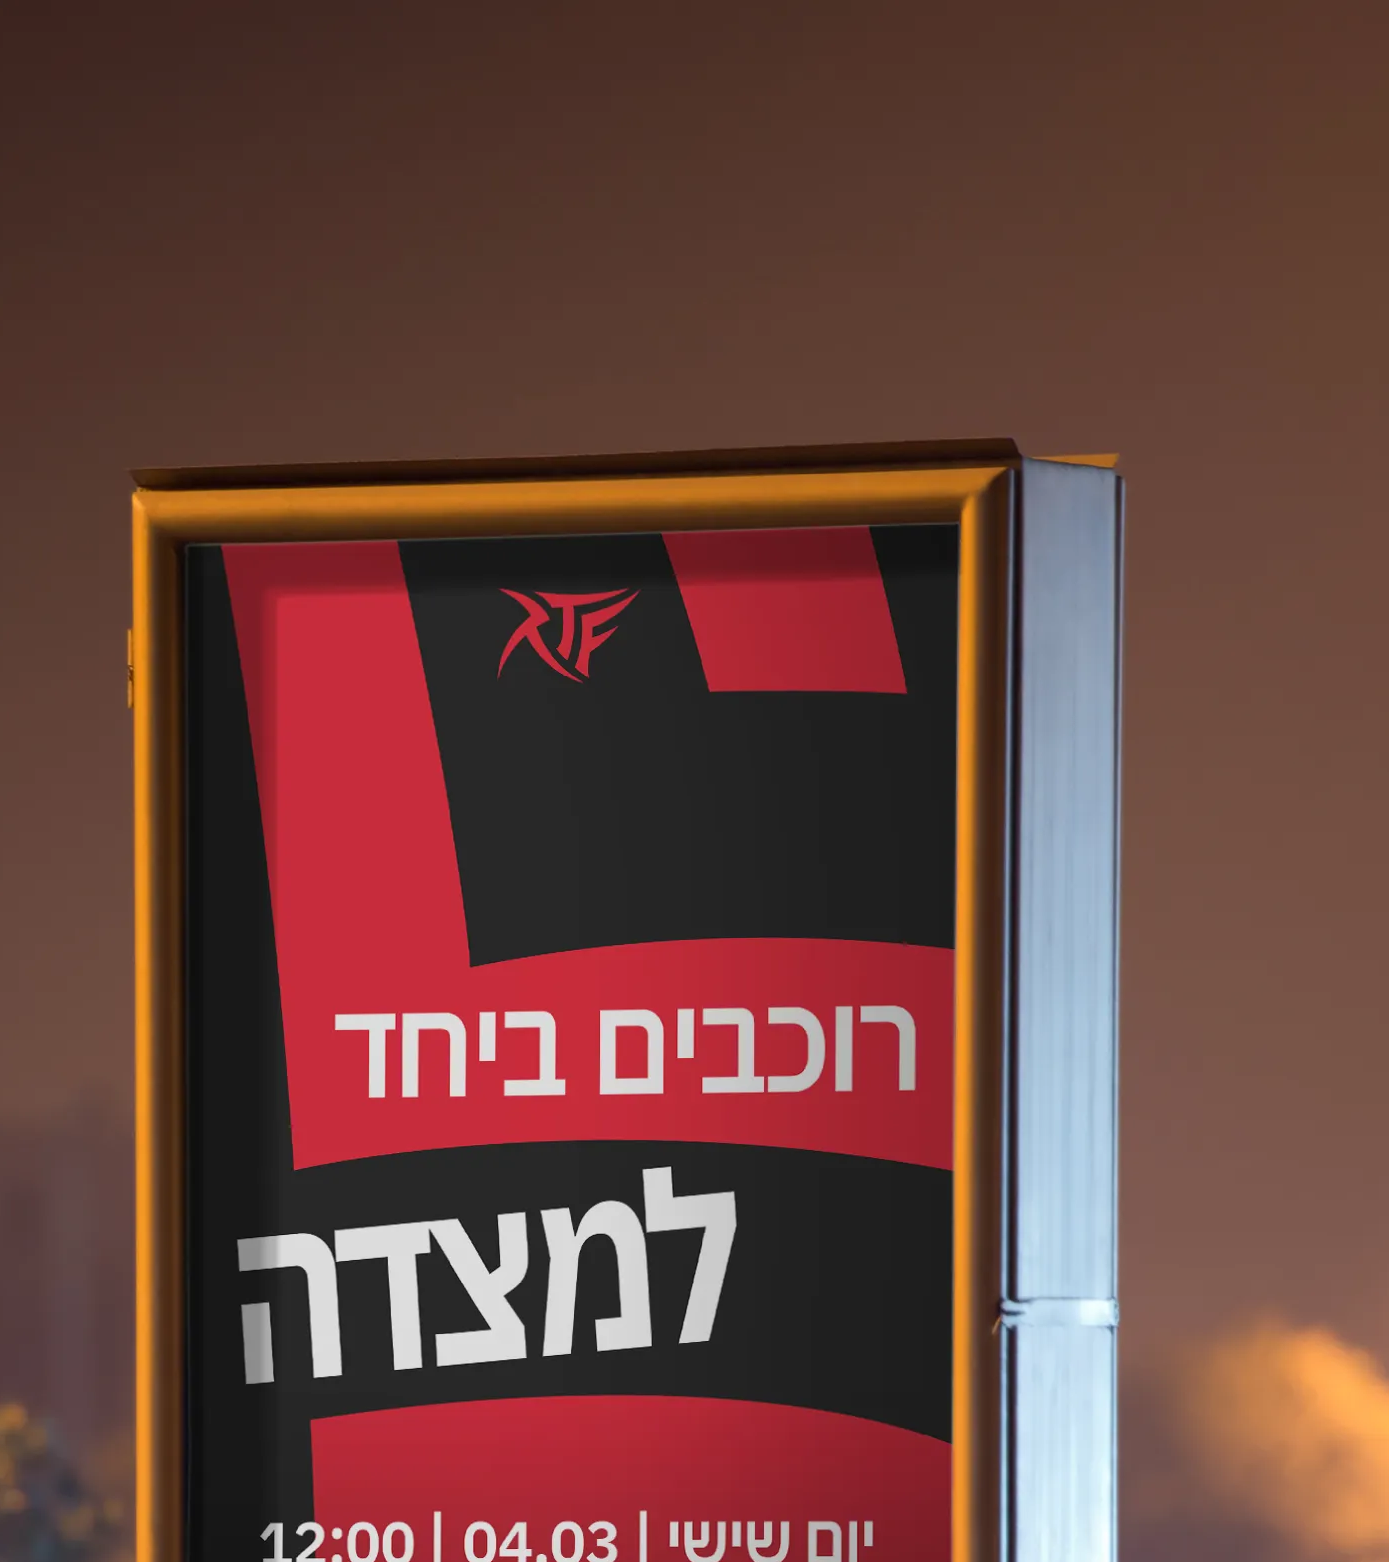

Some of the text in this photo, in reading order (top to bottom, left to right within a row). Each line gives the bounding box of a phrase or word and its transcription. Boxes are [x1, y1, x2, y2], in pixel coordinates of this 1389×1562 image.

[334, 1005, 916, 1099] רוכבים ביחד
[236, 1165, 738, 1385] למצדה
